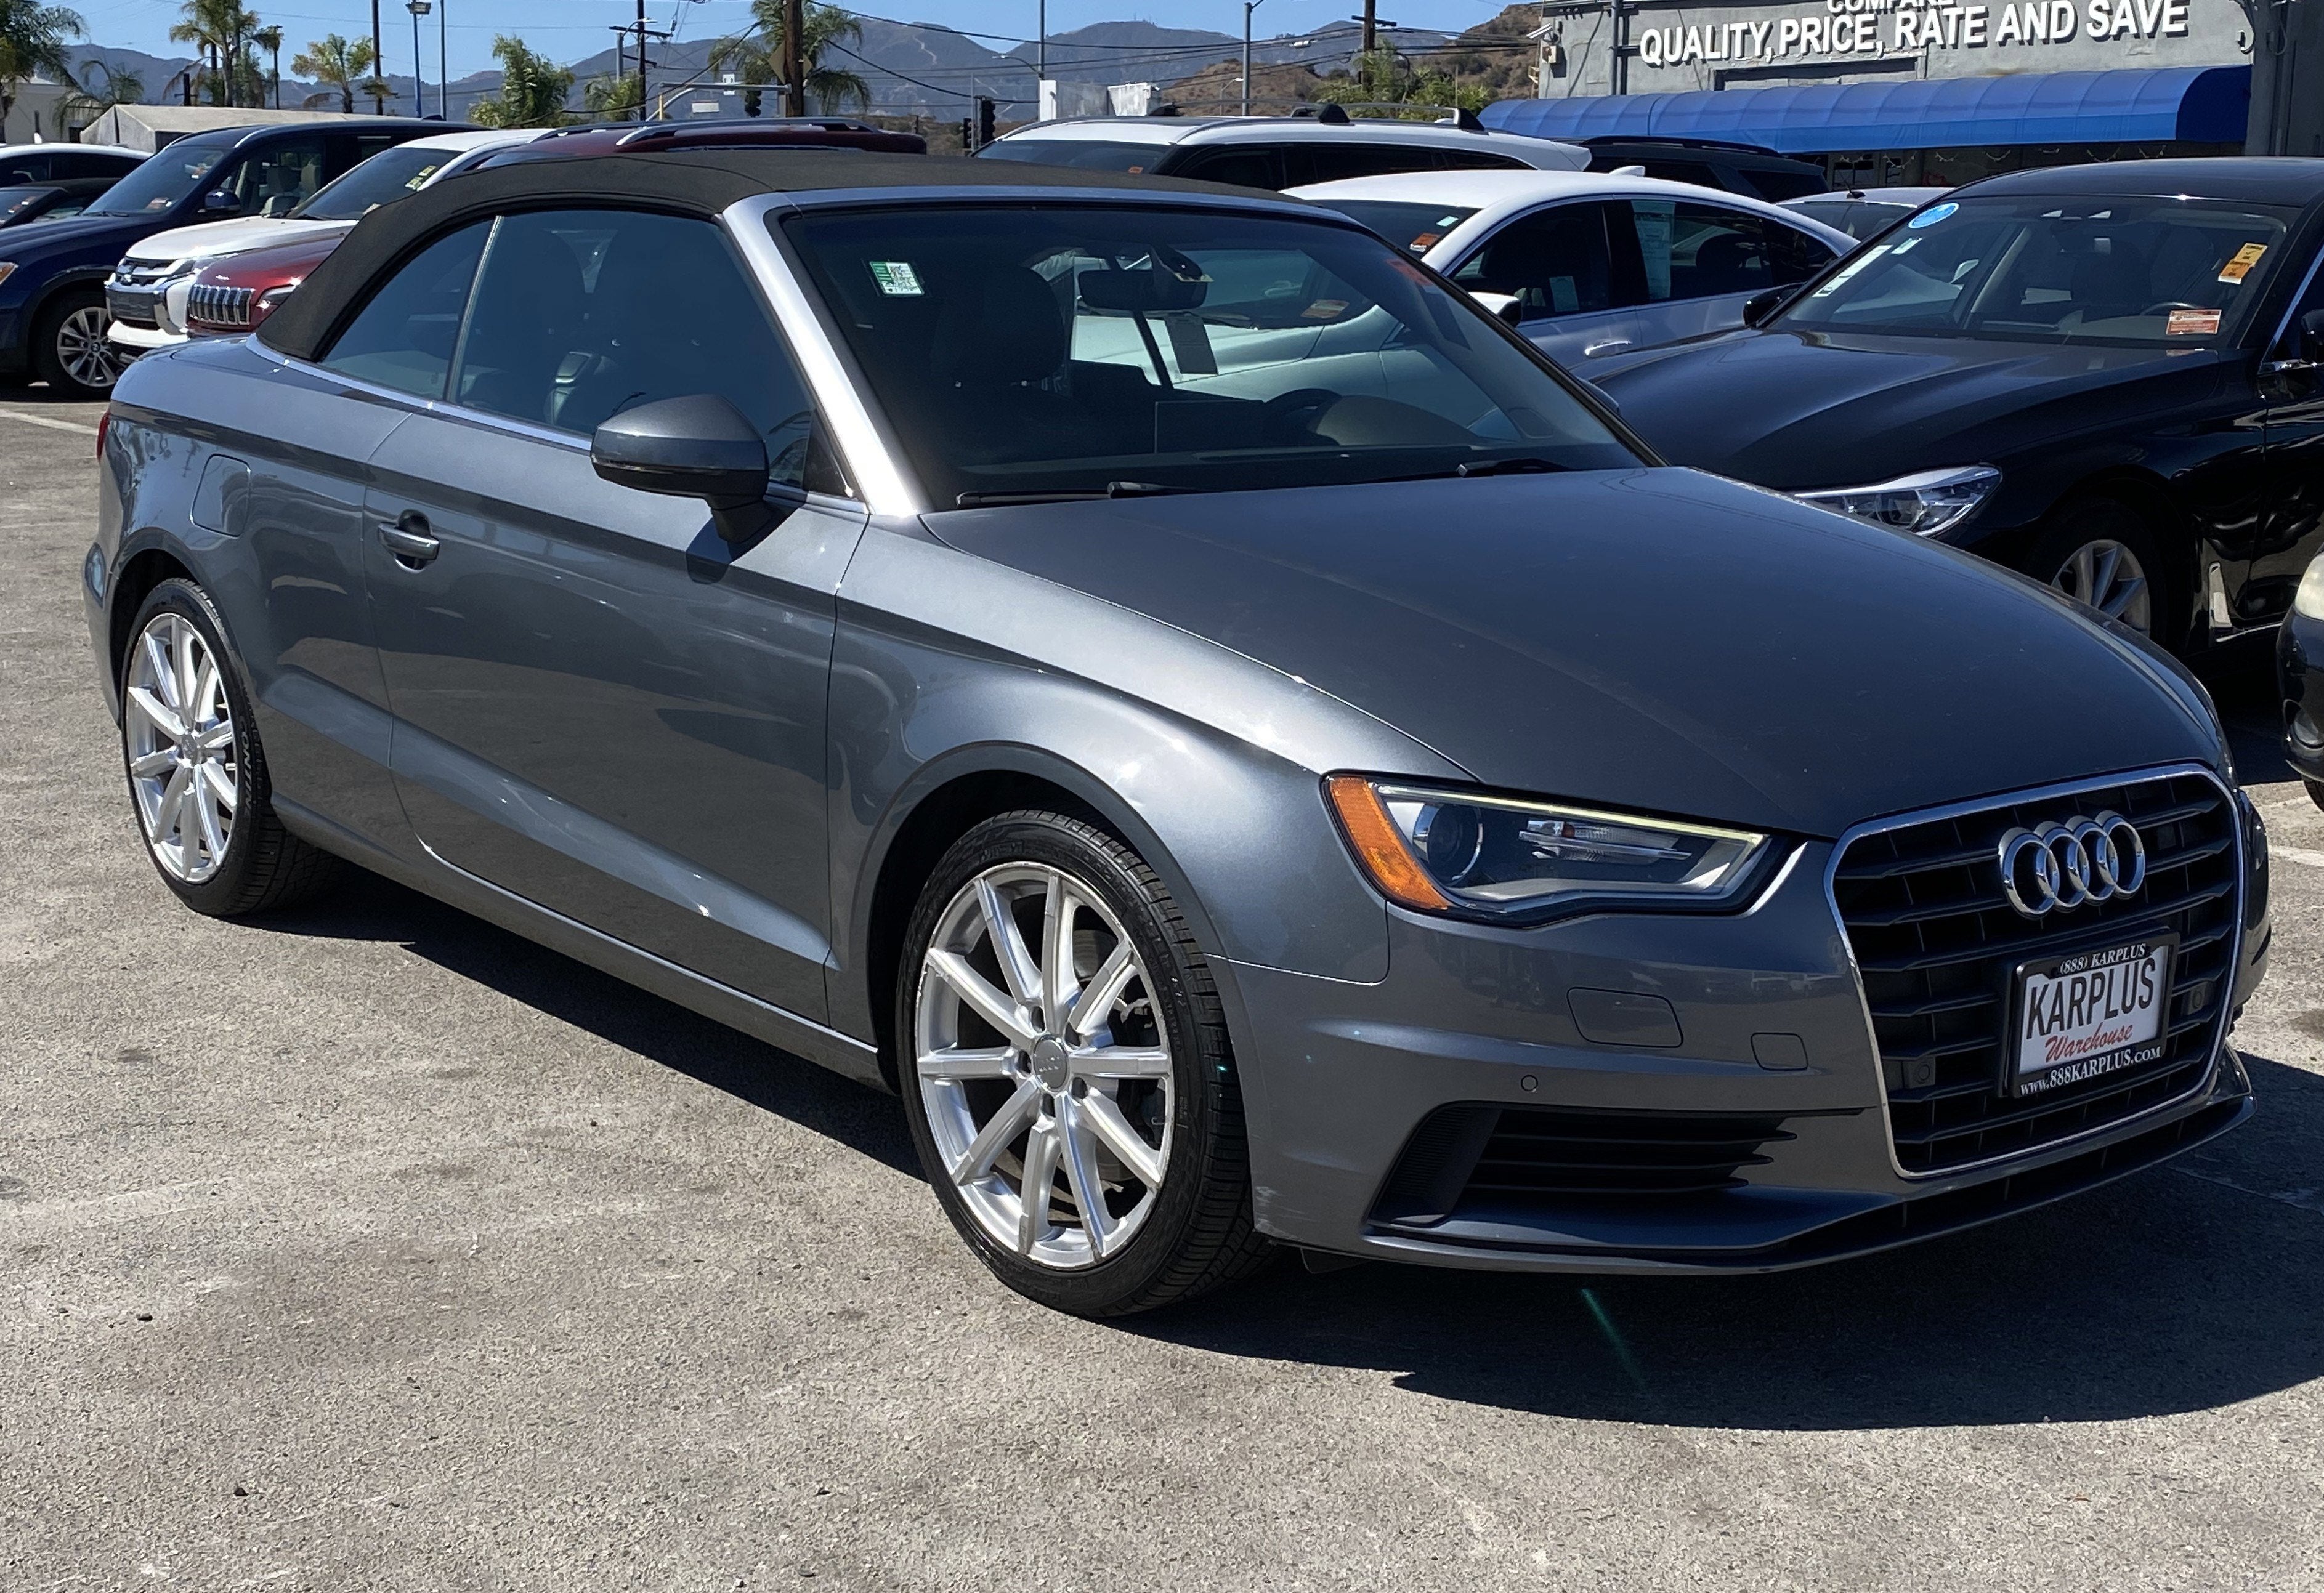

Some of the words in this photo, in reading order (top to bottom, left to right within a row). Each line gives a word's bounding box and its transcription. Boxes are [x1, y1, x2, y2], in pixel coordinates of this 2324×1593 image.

[1640, 21, 1773, 65] QUALITY,
[1779, 13, 1883, 58] PRICE,
[1895, 6, 1986, 47] RATE
[1995, 1, 2076, 42] AND
[2086, 0, 2188, 37] SAVE
[2060, 956, 2089, 975] (888)
[2091, 943, 2147, 967] KARPLUS
[2026, 958, 2156, 1039] KARPLUS
[2045, 1022, 2133, 1063] Warehouse
